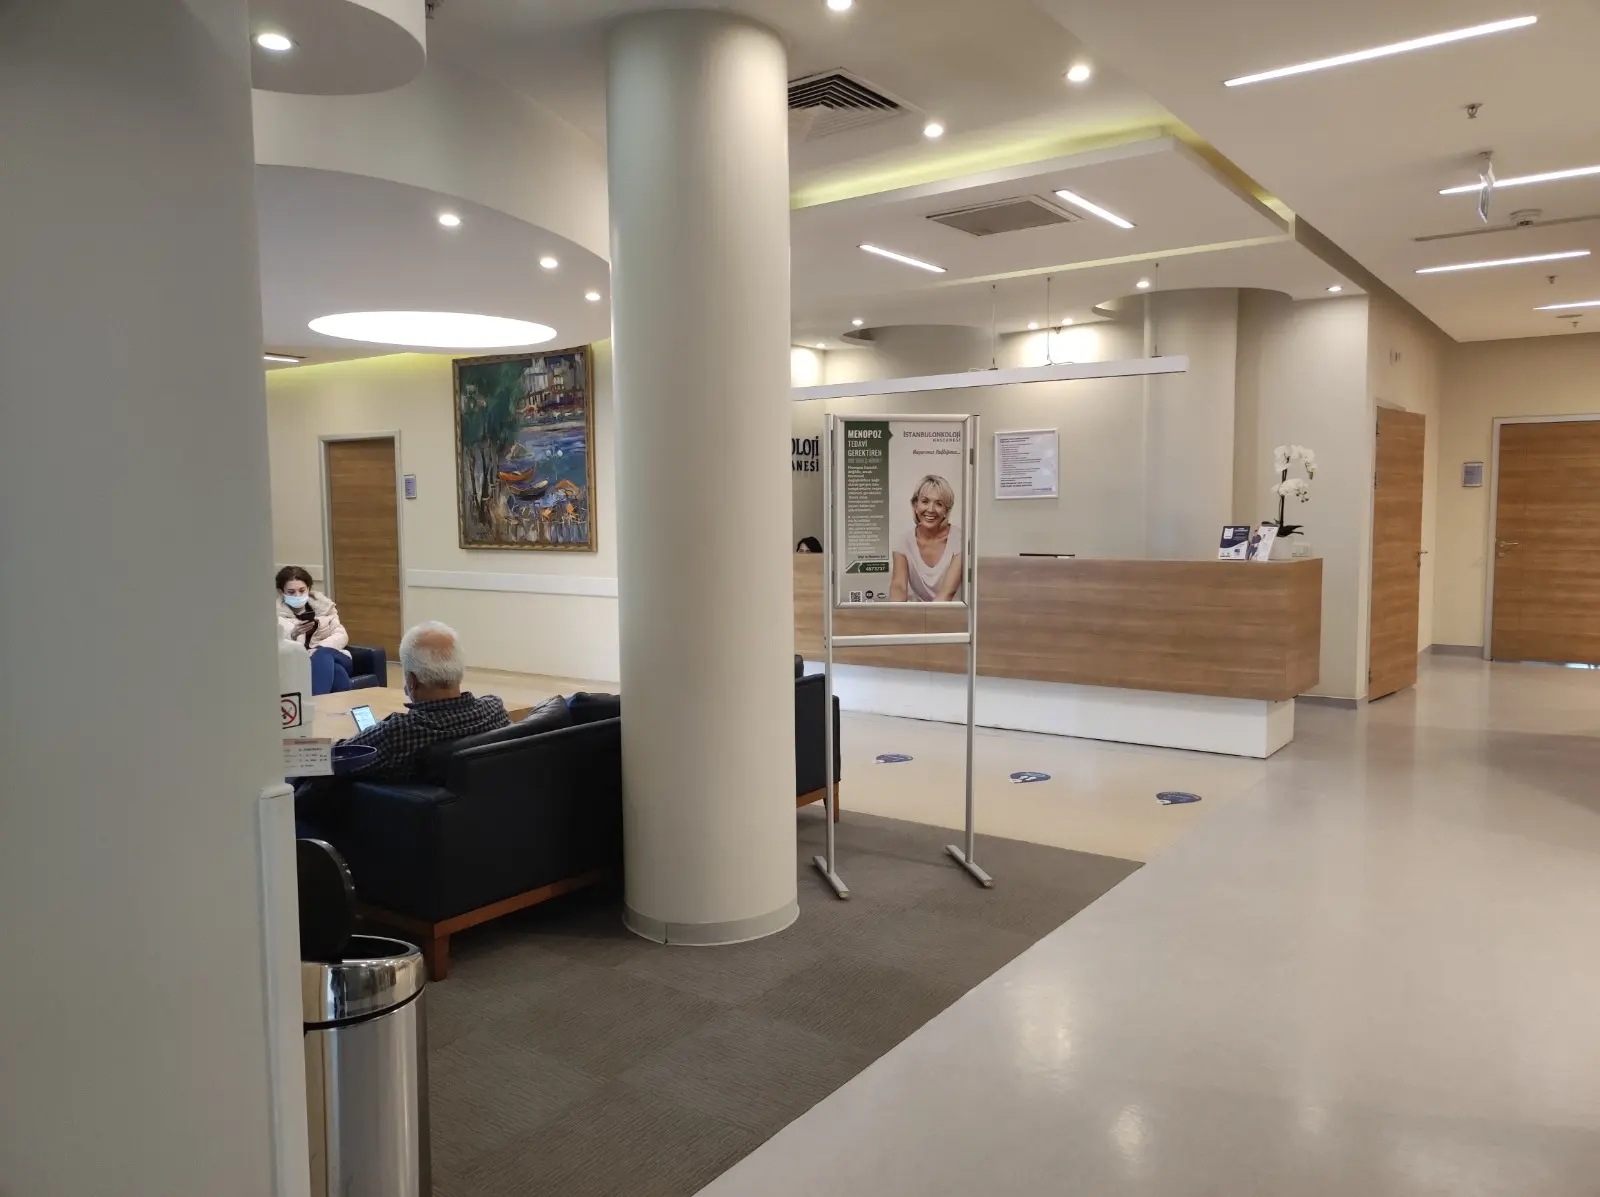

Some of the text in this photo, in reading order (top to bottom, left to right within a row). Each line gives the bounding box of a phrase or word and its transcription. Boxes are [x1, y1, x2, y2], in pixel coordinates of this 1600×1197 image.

[847, 429, 882, 438] MENOPOZ
[848, 439, 868, 447] TEDAVİ
[847, 448, 882, 457] GEREKTİREN
